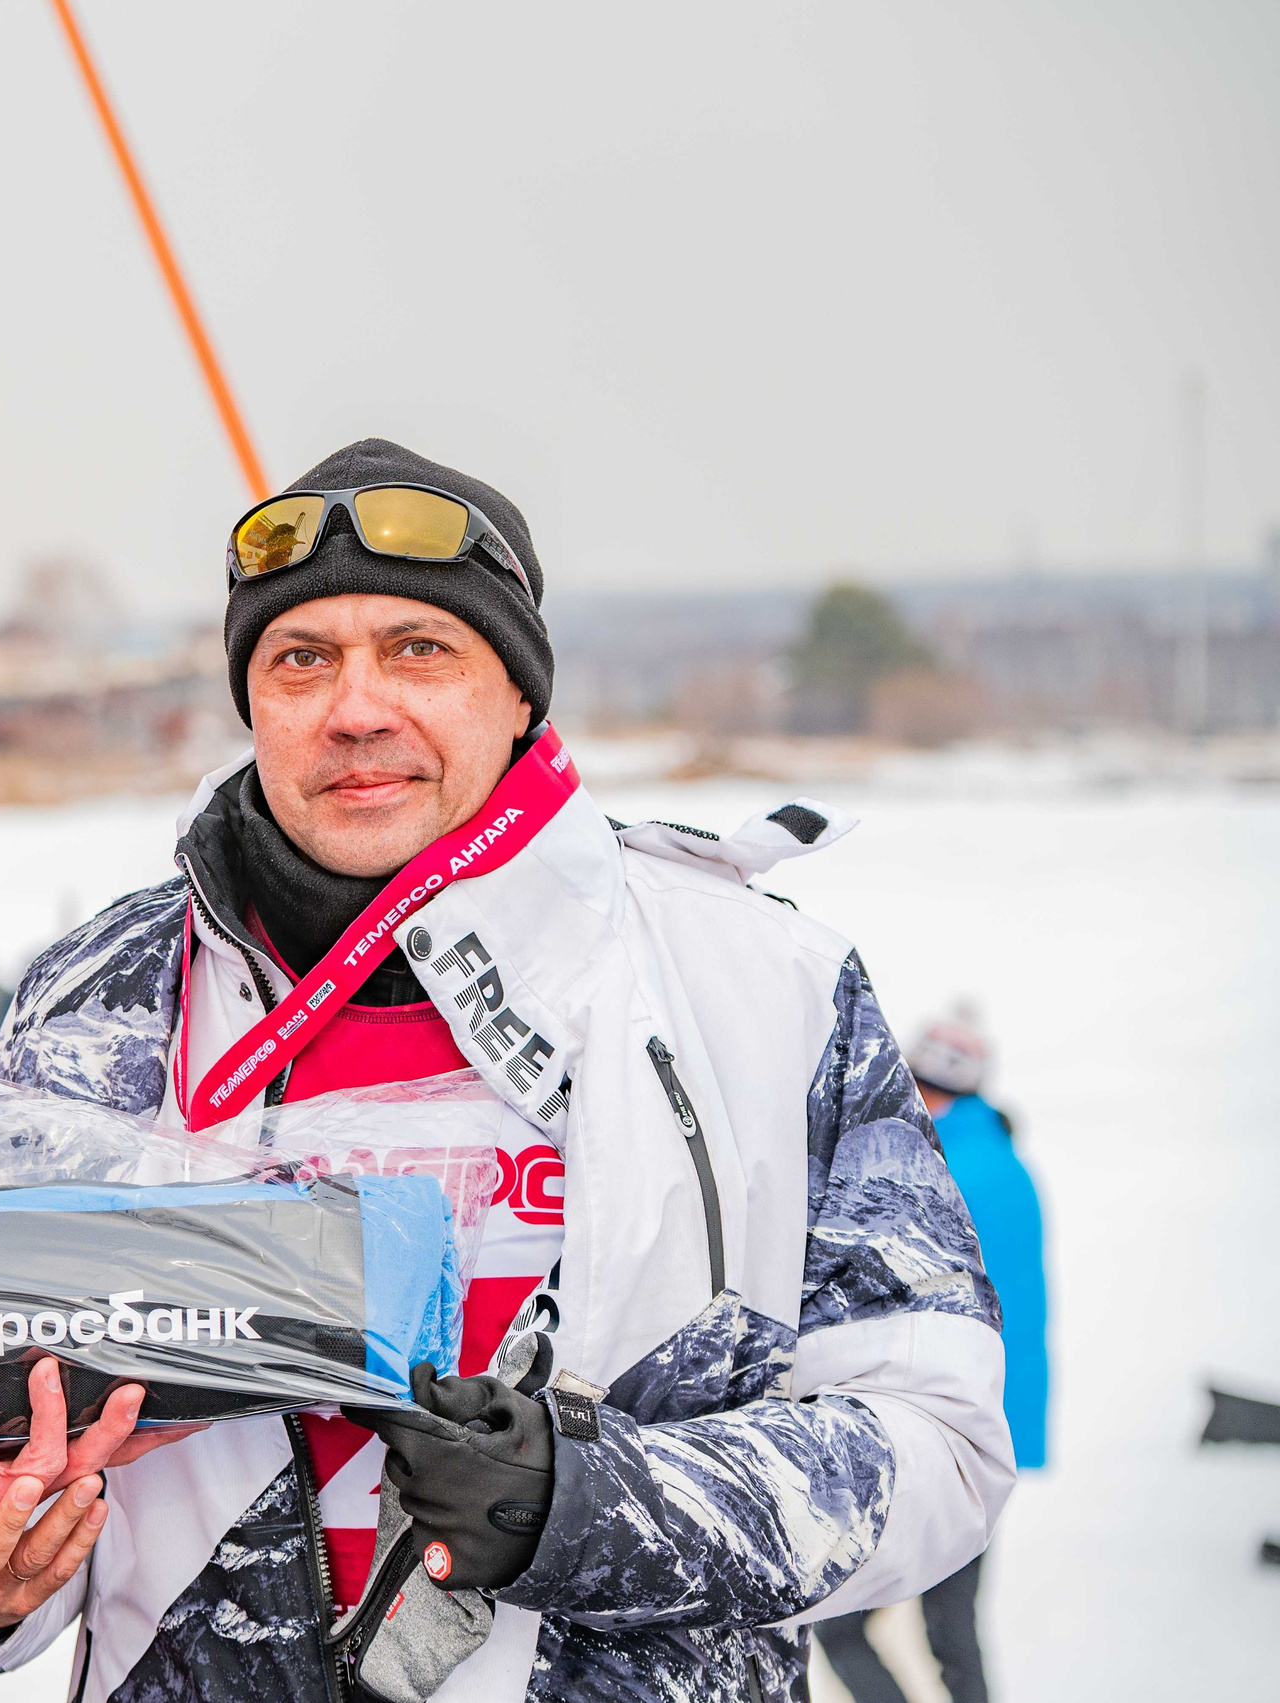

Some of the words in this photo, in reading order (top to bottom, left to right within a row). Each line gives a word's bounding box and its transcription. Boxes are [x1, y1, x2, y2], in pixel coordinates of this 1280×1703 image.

[343, 873, 444, 967] ТЕМЕРСО
[449, 807, 525, 876] АНГАРА
[276, 1009, 306, 1037] БАМ
[209, 1038, 277, 1109] ТЕМЕРСО
